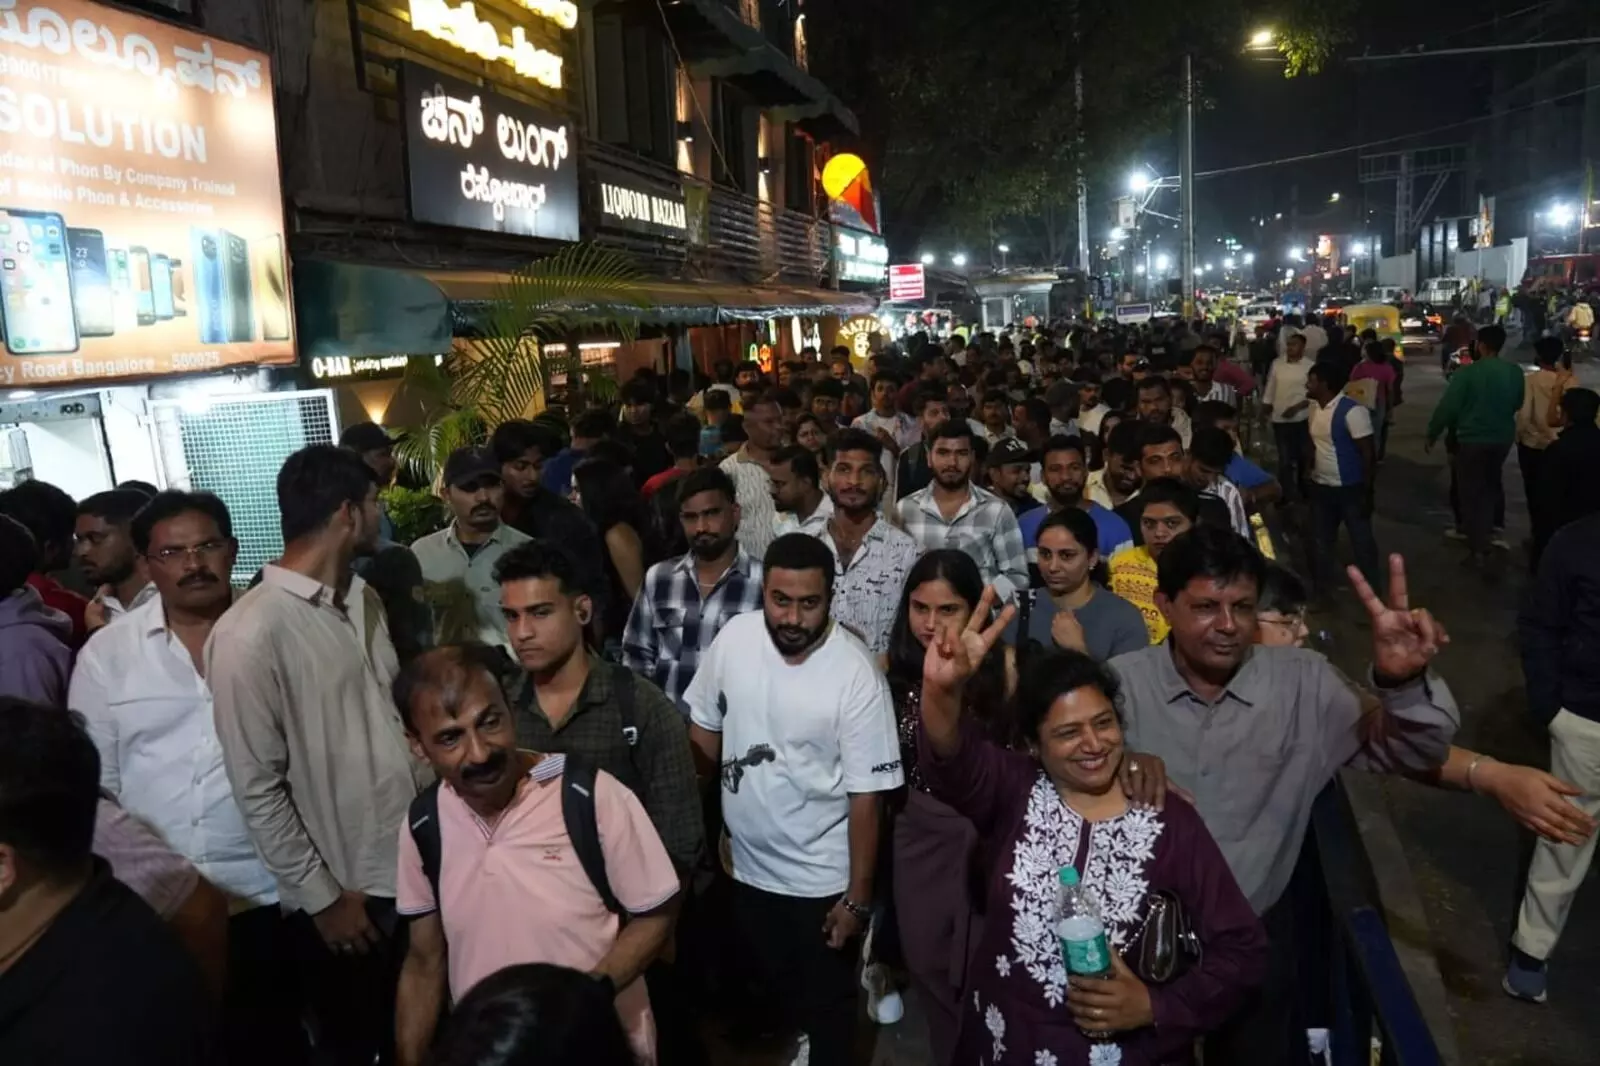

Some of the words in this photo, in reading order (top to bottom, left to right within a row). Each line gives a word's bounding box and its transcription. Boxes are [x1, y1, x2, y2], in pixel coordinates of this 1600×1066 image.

[0, 85, 208, 163] SOLUTION
[103, 164, 122, 185] By
[125, 167, 188, 192] Company
[77, 185, 116, 206] Phon
[22, 360, 68, 379] Road
[72, 357, 155, 377] Bangalore
